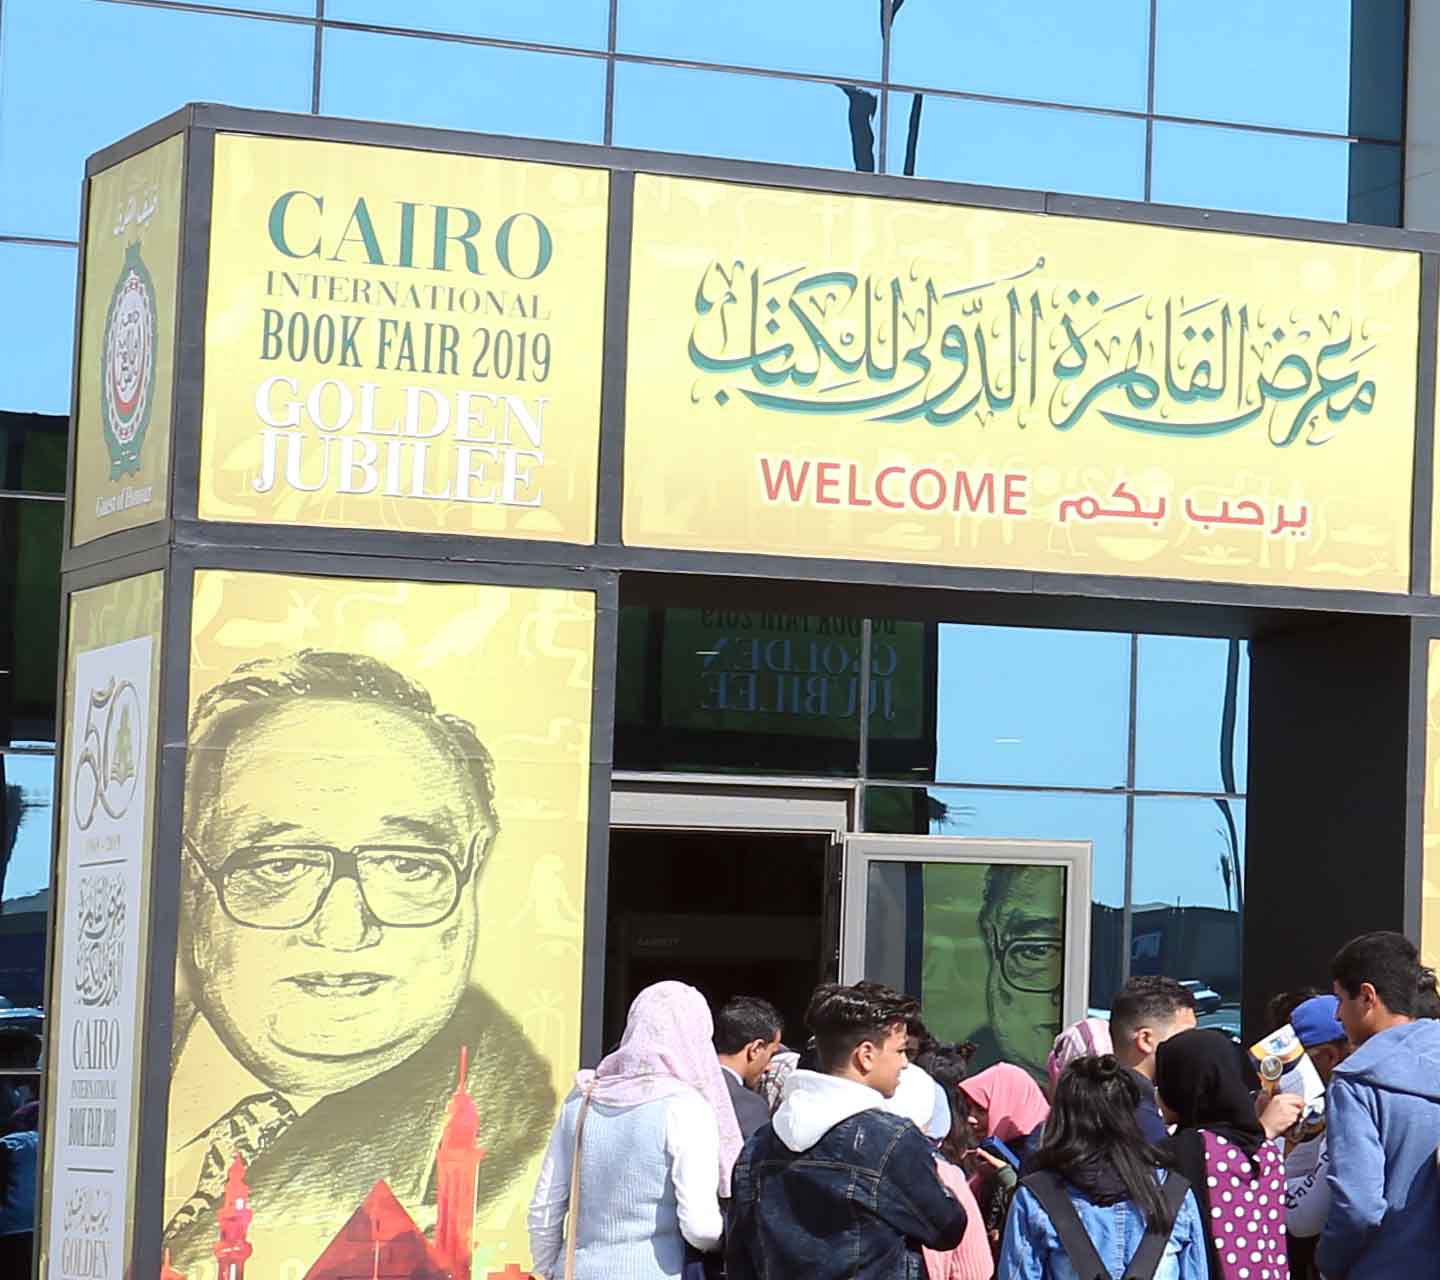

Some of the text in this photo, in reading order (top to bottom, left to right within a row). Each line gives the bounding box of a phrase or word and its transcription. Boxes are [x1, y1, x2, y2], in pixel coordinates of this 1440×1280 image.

[268, 190, 553, 280] CAIRO
[264, 270, 552, 320] INTERNATIONAL
[260, 308, 551, 382] BOOK FAIR 2019
[255, 375, 549, 448] GOLDEN
[253, 429, 544, 508] JUBILEE
[760, 458, 1027, 516] WELCOME
[1059, 482, 1308, 536] يرحب بكم
[72, 1018, 120, 1072] CAIRO
[61, 1236, 111, 1278] GOLDEN
